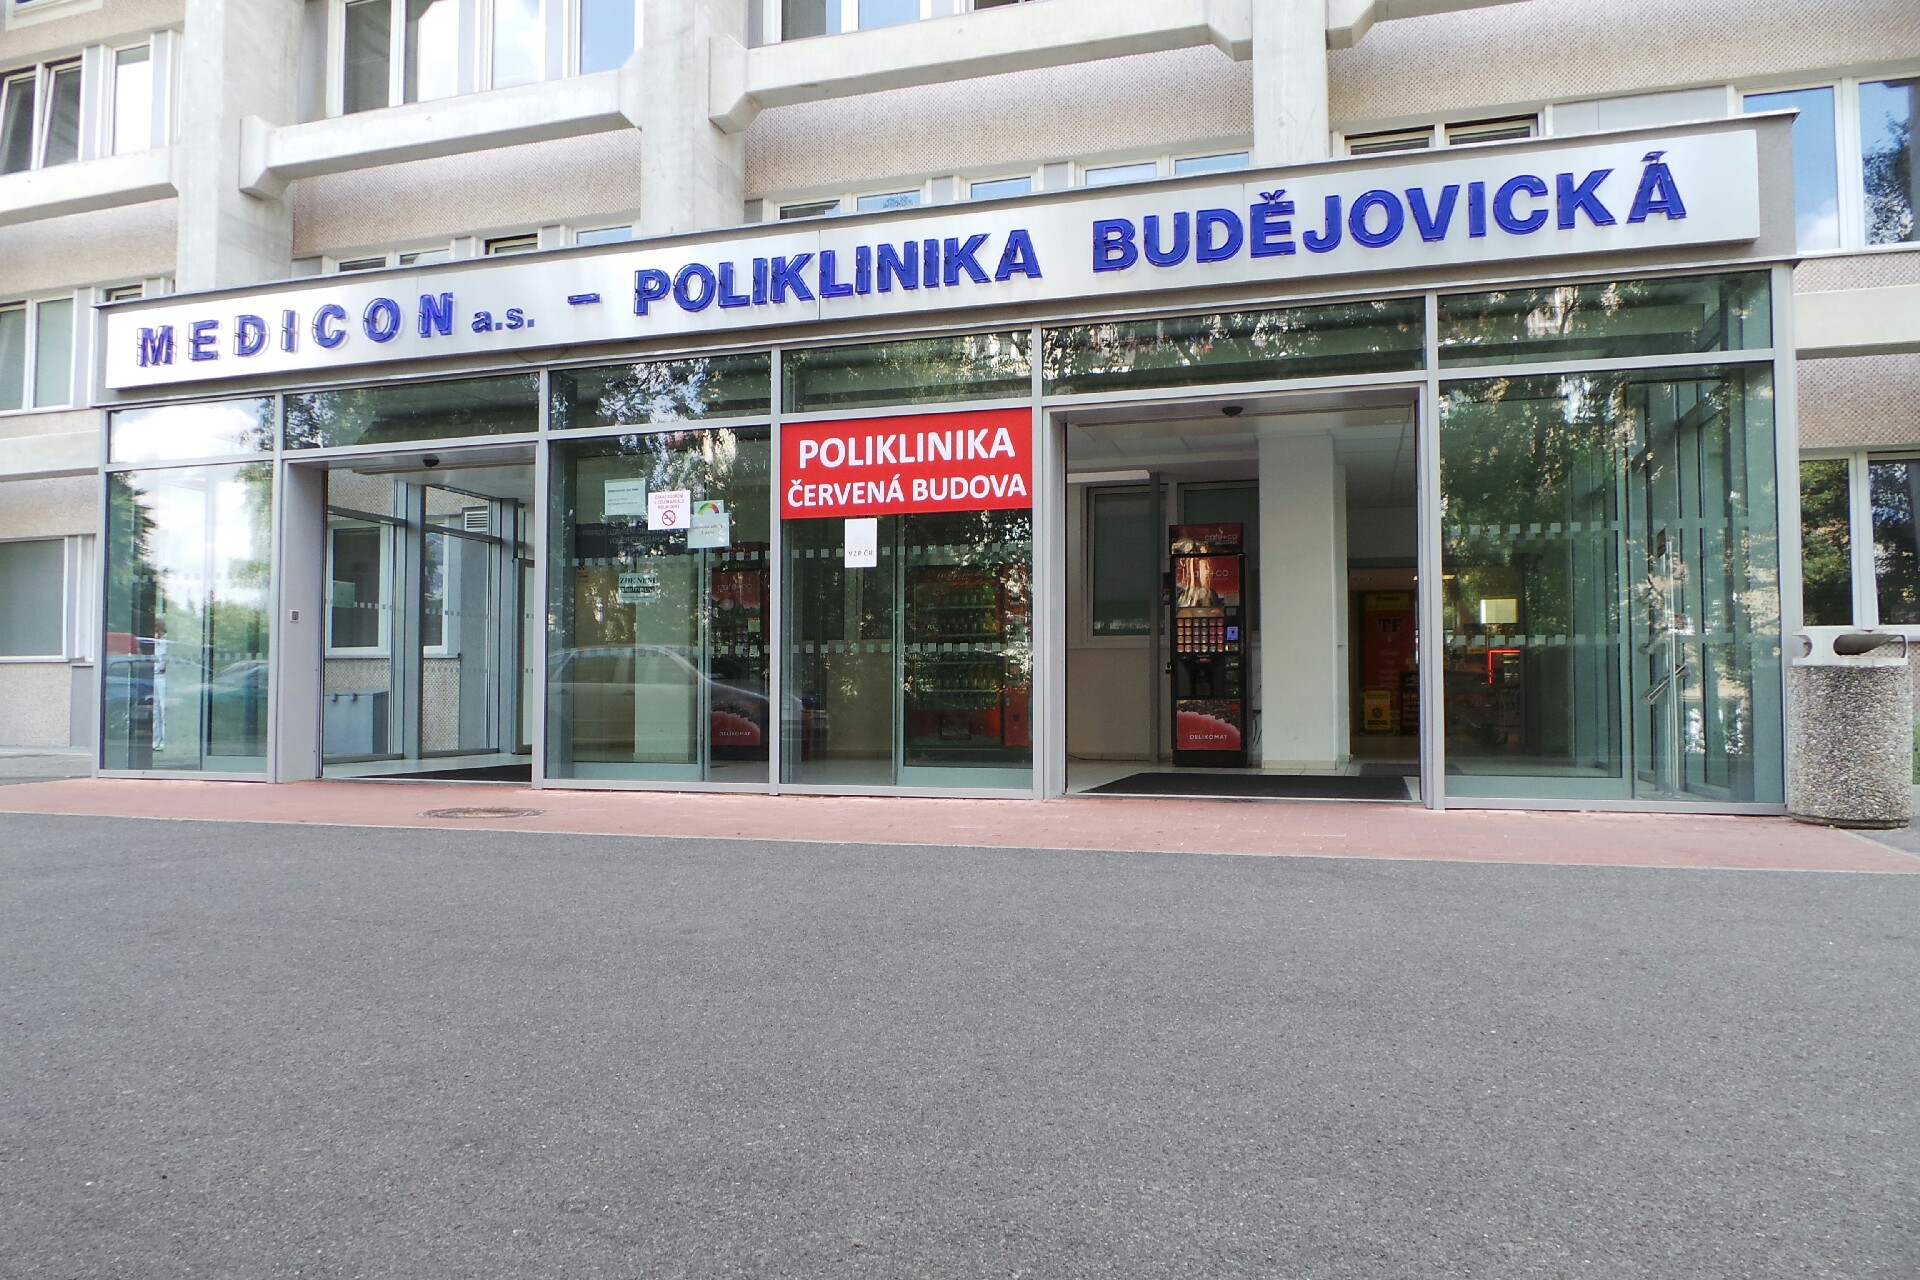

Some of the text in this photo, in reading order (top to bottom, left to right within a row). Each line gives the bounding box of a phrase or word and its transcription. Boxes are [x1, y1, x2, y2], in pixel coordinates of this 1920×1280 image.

[137, 292, 454, 367] MEDICON
[471, 307, 535, 333] a.s.
[634, 229, 1042, 316] POLIKLINIKA
[1093, 151, 1687, 273] BUDĚJOVICKÁ
[799, 427, 1015, 469] POLIKLINIKA
[787, 473, 1027, 508] ČERVENÁ BUDOVA
